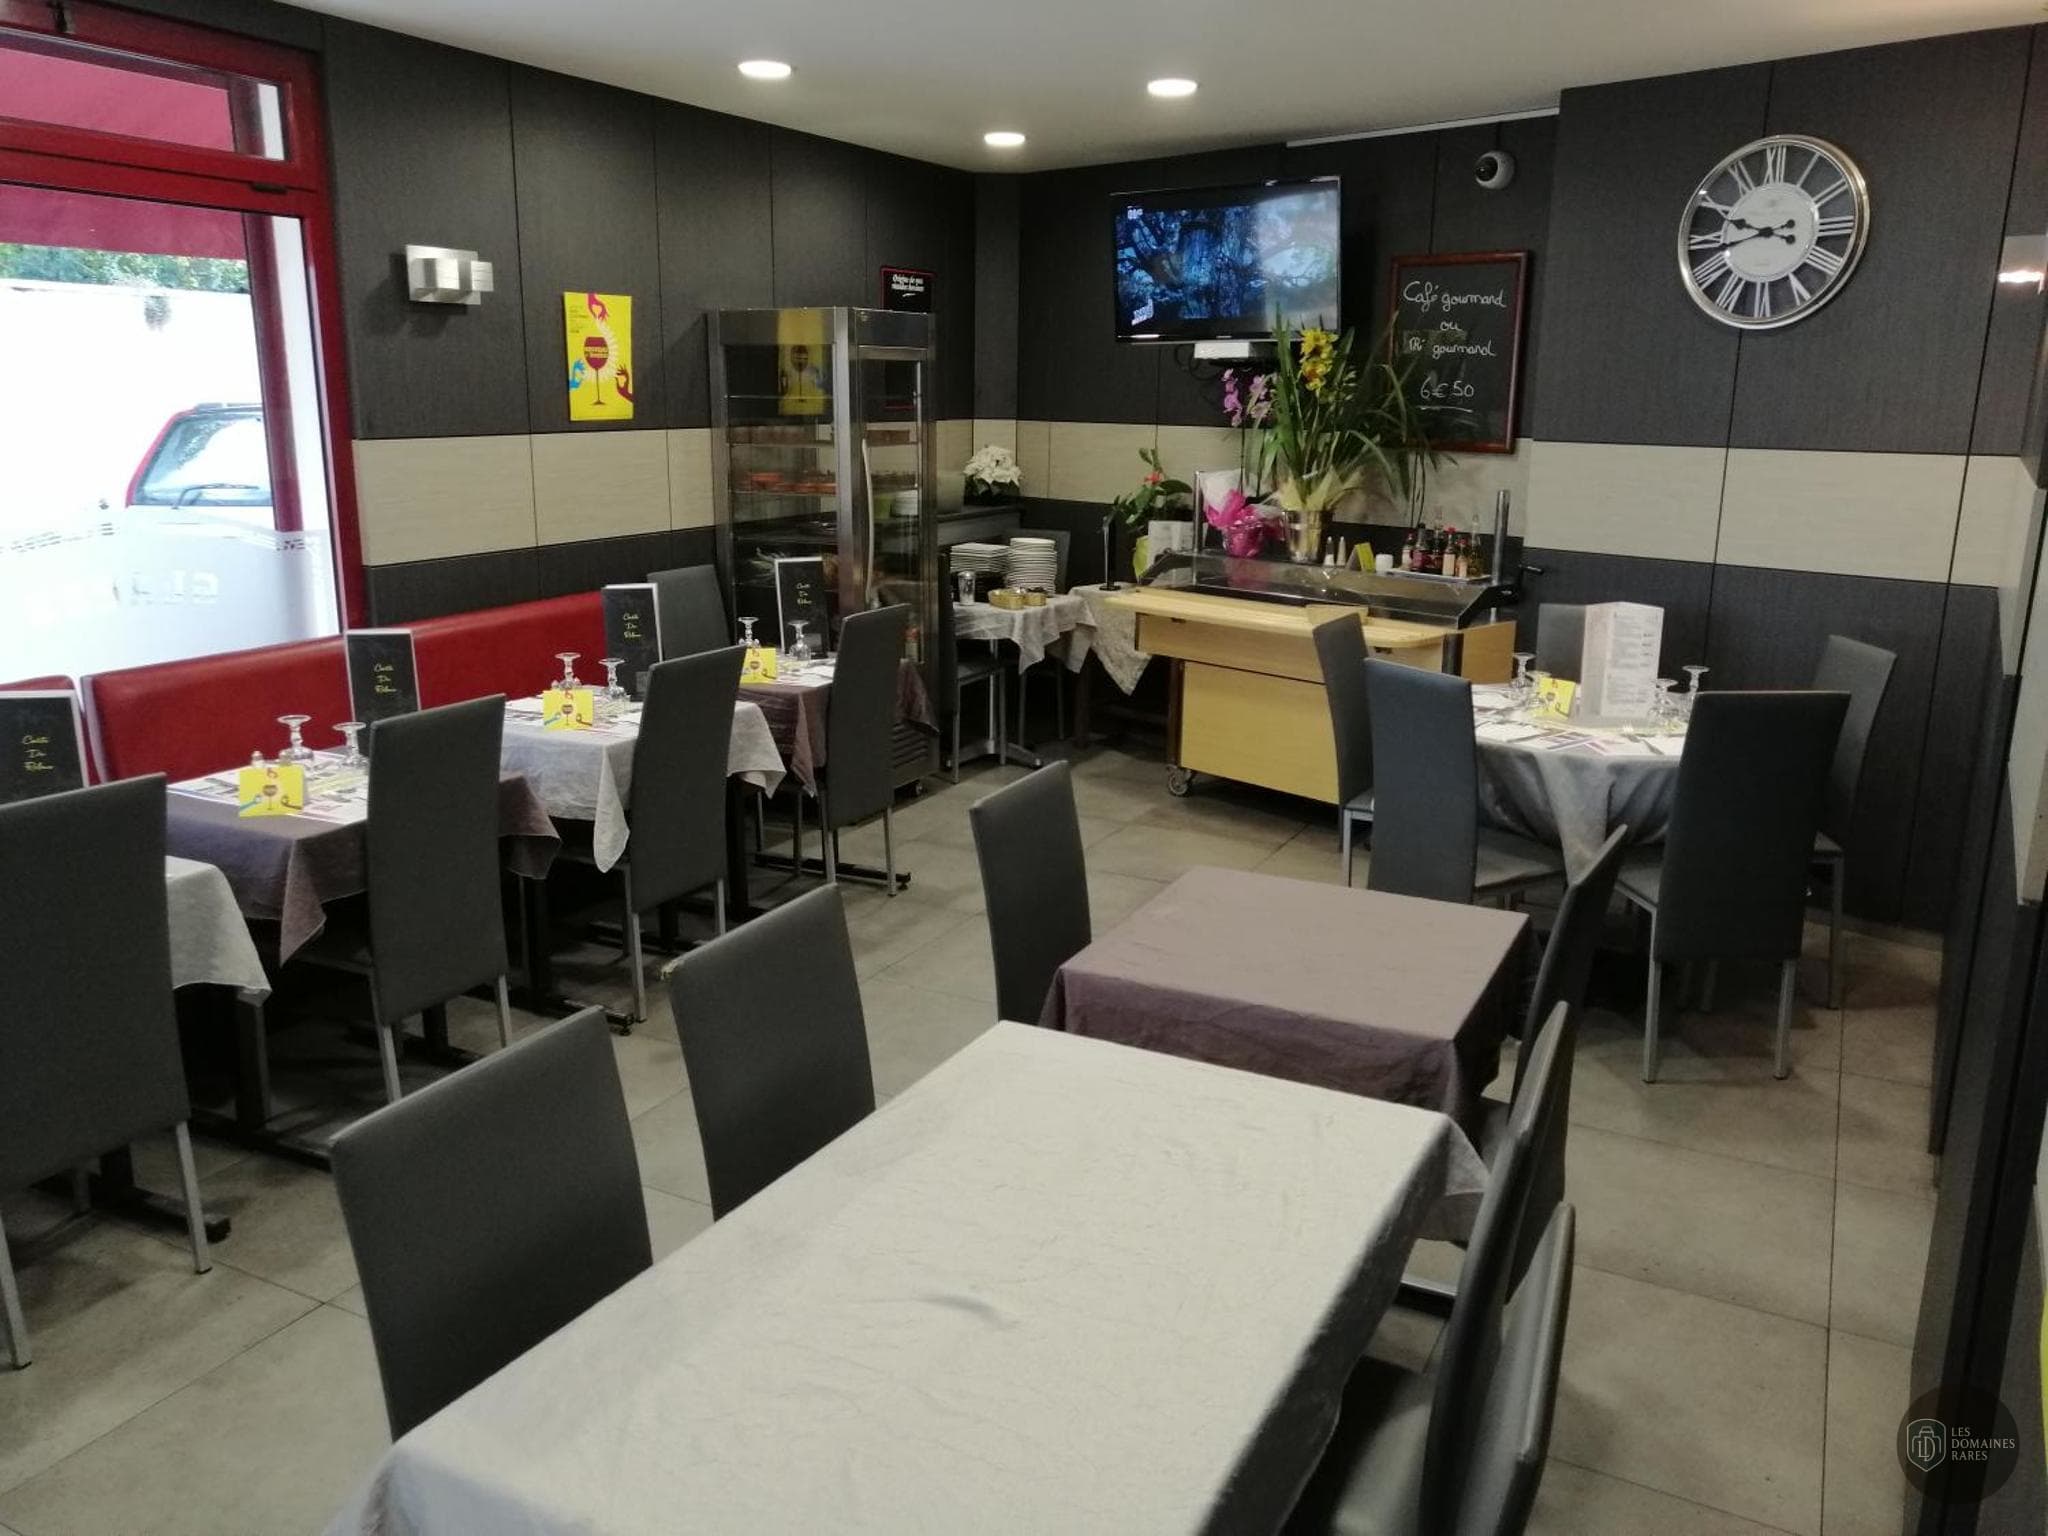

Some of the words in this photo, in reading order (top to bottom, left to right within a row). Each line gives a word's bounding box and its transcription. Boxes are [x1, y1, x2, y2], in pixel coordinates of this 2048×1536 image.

[1403, 281, 1440, 312] Café
[1441, 290, 1507, 312] gourmand
[1440, 321, 1463, 331] ou
[1432, 339, 1497, 360] gourmand
